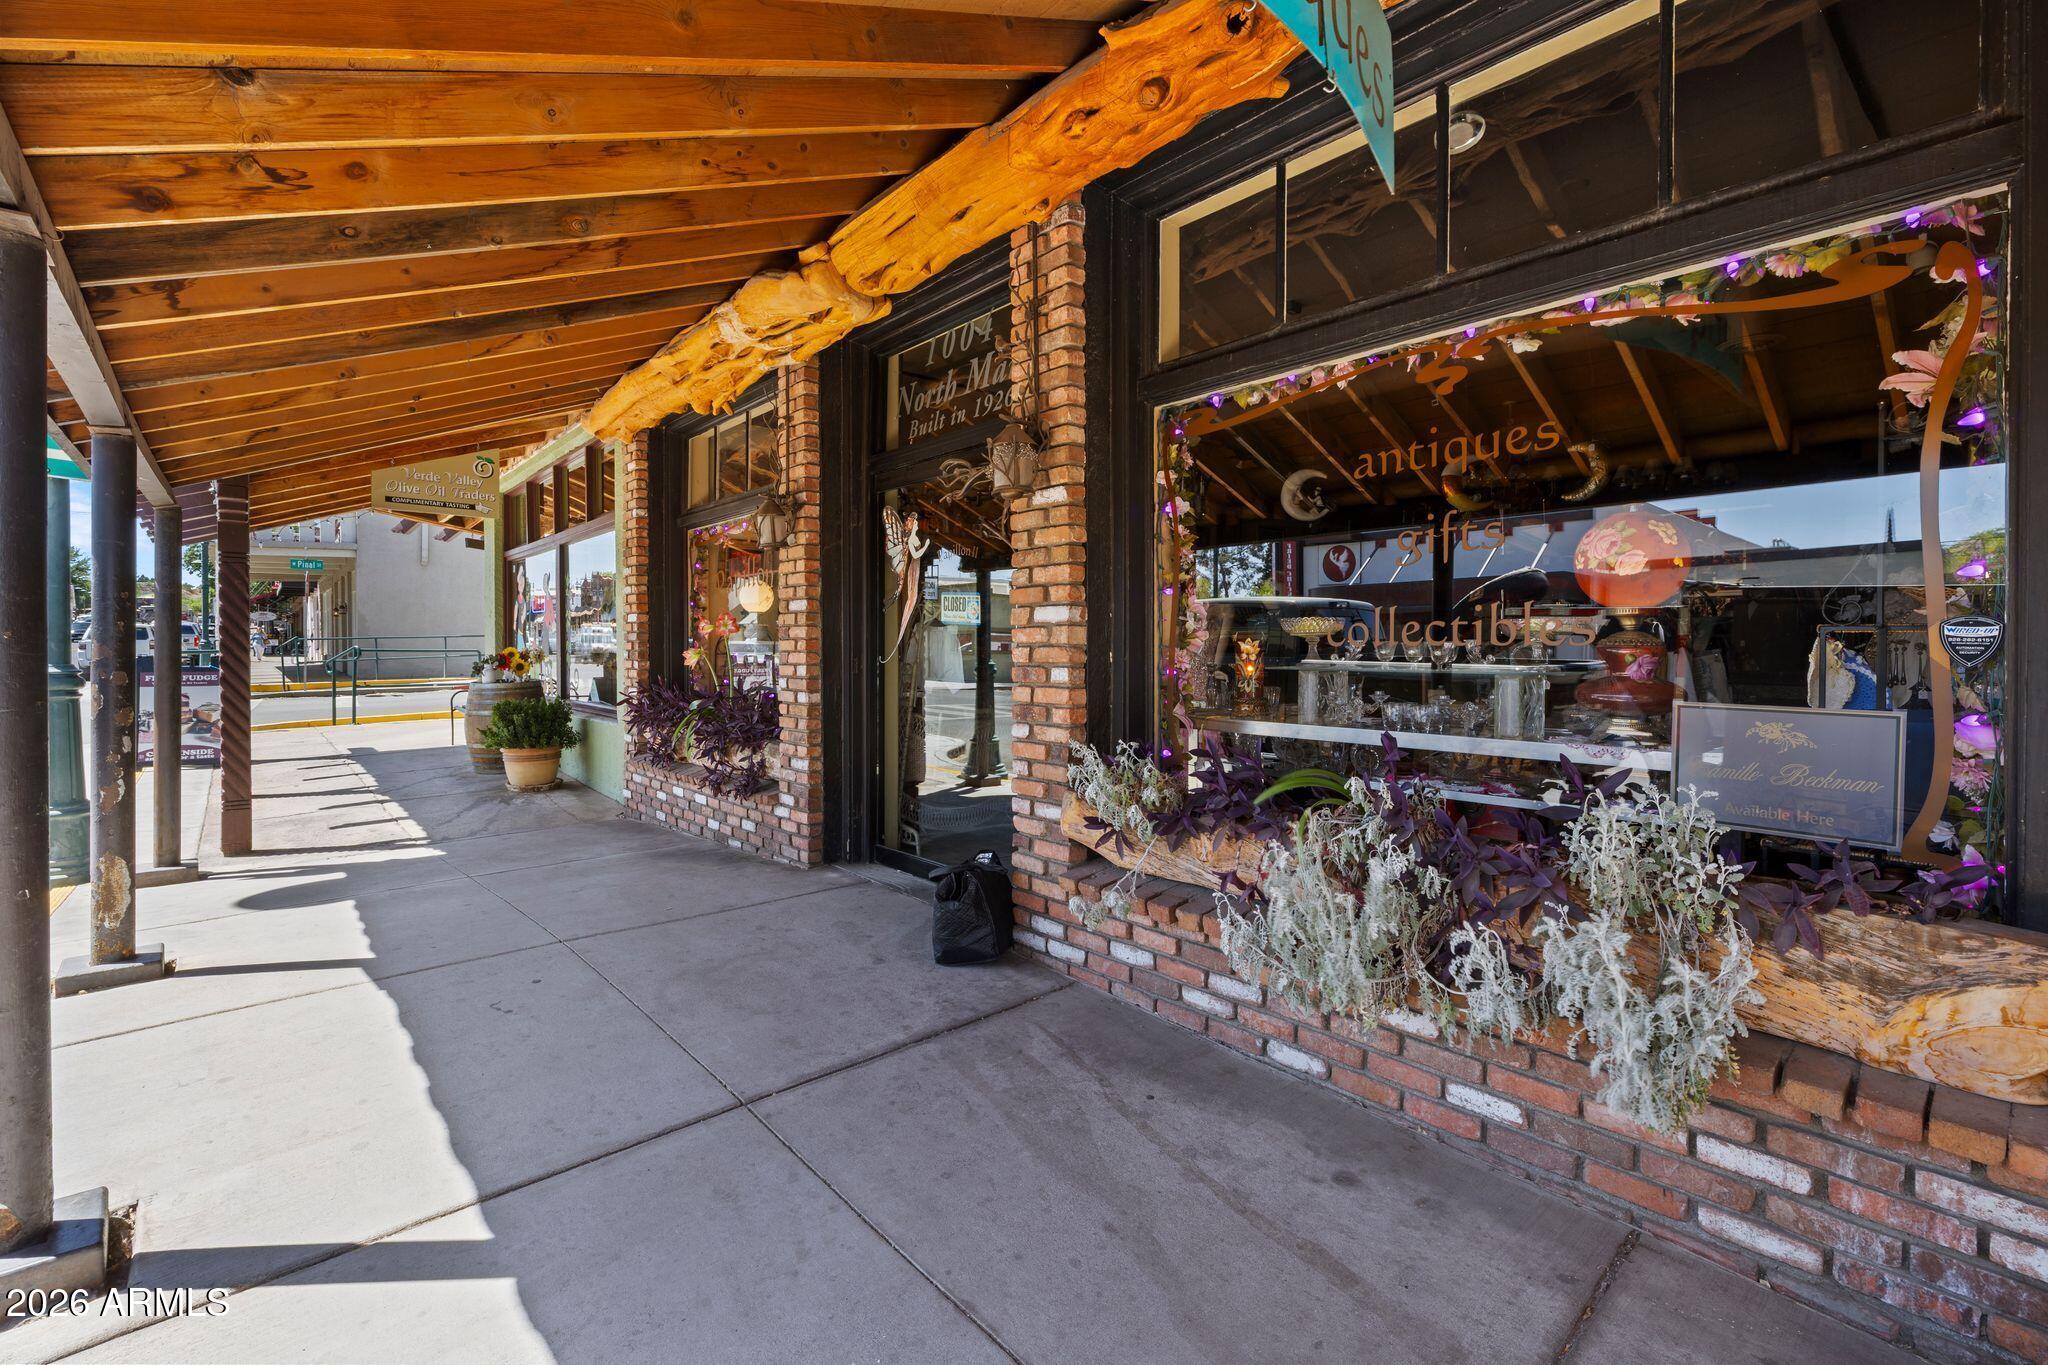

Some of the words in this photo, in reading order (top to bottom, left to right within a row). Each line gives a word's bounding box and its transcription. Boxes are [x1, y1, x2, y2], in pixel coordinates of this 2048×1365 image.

[1306, 0, 1386, 128] ues
[925, 307, 993, 367] 1004
[899, 368, 957, 415] North
[965, 351, 1012, 394] Ma
[908, 410, 946, 440] Built
[950, 405, 966, 426] in
[1353, 419, 1561, 480] antiques
[385, 479, 420, 495] Olive
[425, 484, 446, 497] Oil
[452, 487, 496, 503] Traders
[401, 464, 441, 482] Verde
[443, 471, 485, 489] Valley
[391, 496, 444, 508] COMPLIMENTARY
[446, 502, 470, 510] TASTING
[1394, 508, 1506, 567] gifts
[297, 560, 316, 569] Pinal
[943, 596, 967, 612] CLOSED
[1327, 599, 1597, 648] collectibles
[181, 748, 214, 756] NSIDE
[1770, 763, 1885, 794] Beckman
[1724, 801, 1790, 821] Available
[1797, 809, 1835, 827] Here
